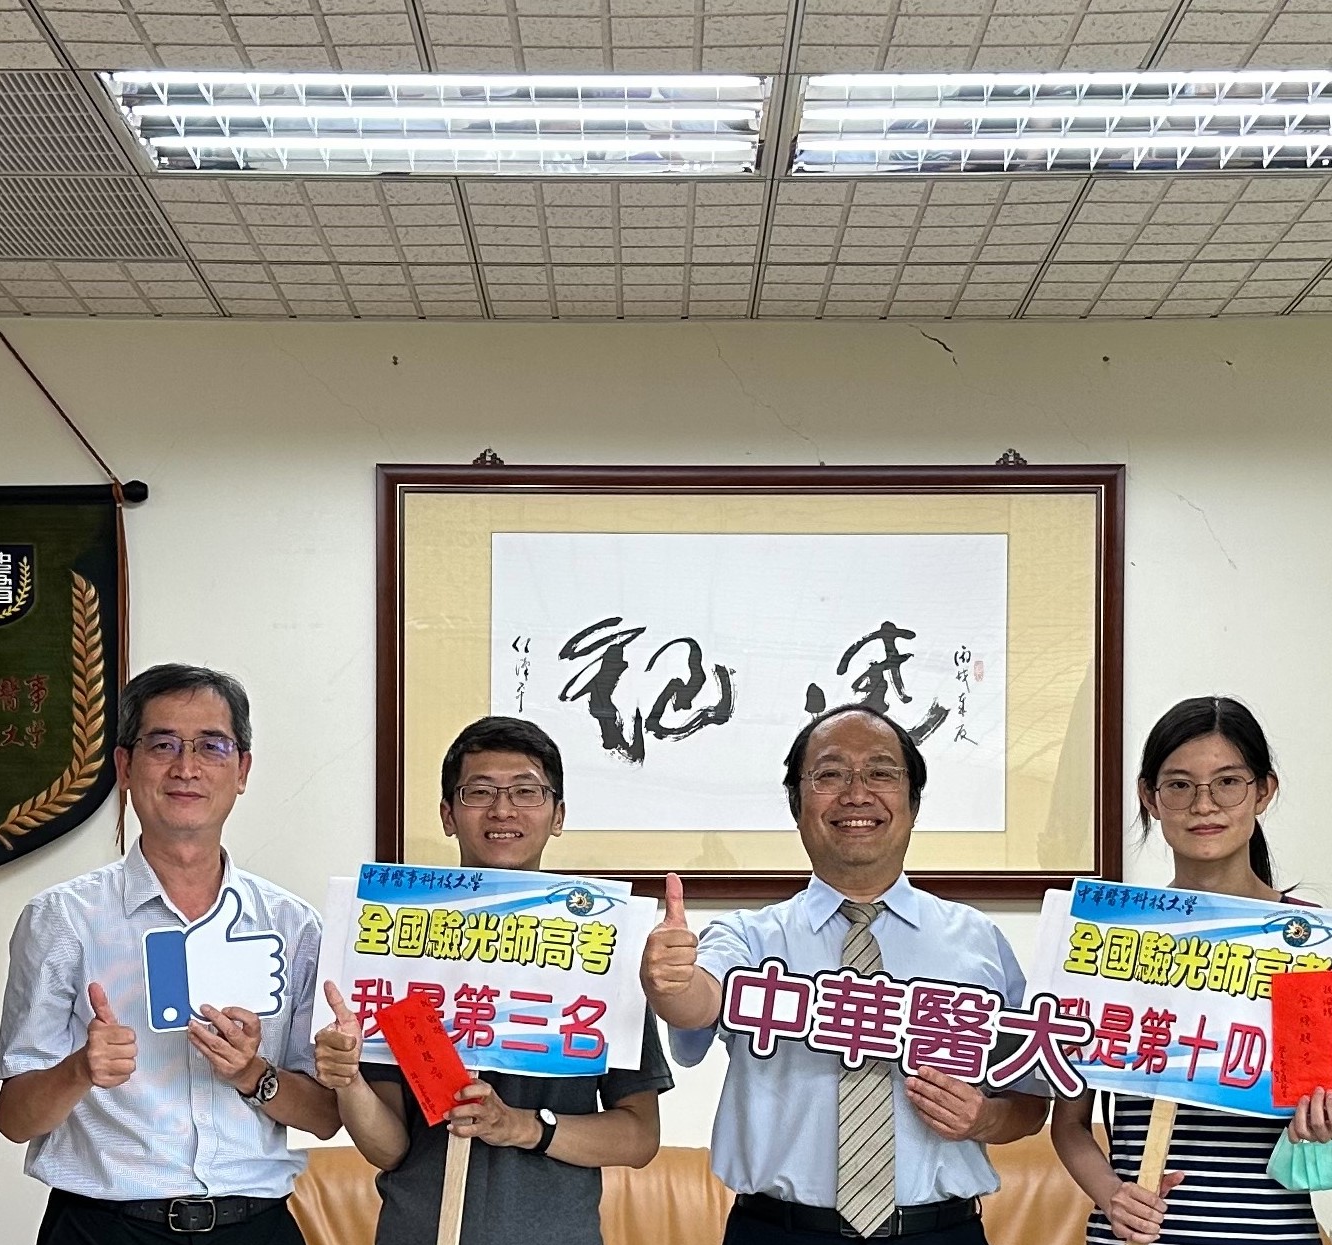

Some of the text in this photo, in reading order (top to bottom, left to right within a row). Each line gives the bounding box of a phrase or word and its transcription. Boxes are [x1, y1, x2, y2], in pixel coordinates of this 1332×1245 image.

[355, 904, 617, 975] 全國驗光師高考
[724, 963, 1087, 1095] 中華醫大
